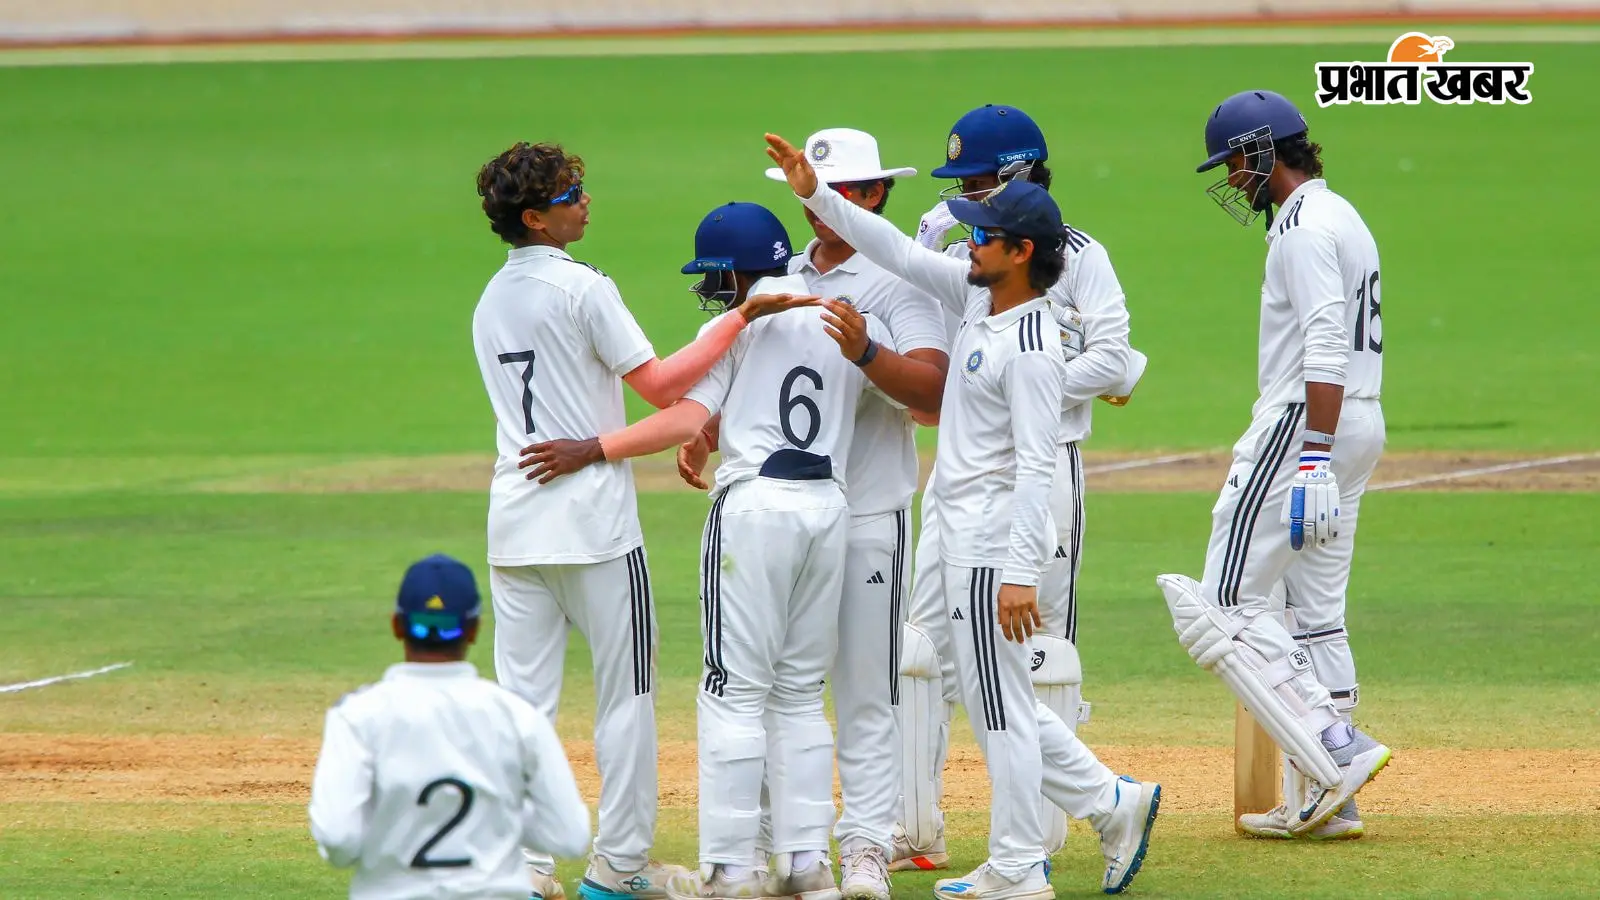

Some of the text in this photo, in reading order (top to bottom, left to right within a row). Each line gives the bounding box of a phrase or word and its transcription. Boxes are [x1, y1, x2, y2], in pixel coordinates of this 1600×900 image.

[1006, 153, 1026, 162] SHREY
[1354, 270, 1383, 354] 18
[497, 349, 536, 435] 7
[778, 365, 824, 450] 6
[1293, 651, 1308, 666] SS
[411, 777, 474, 868] 2
